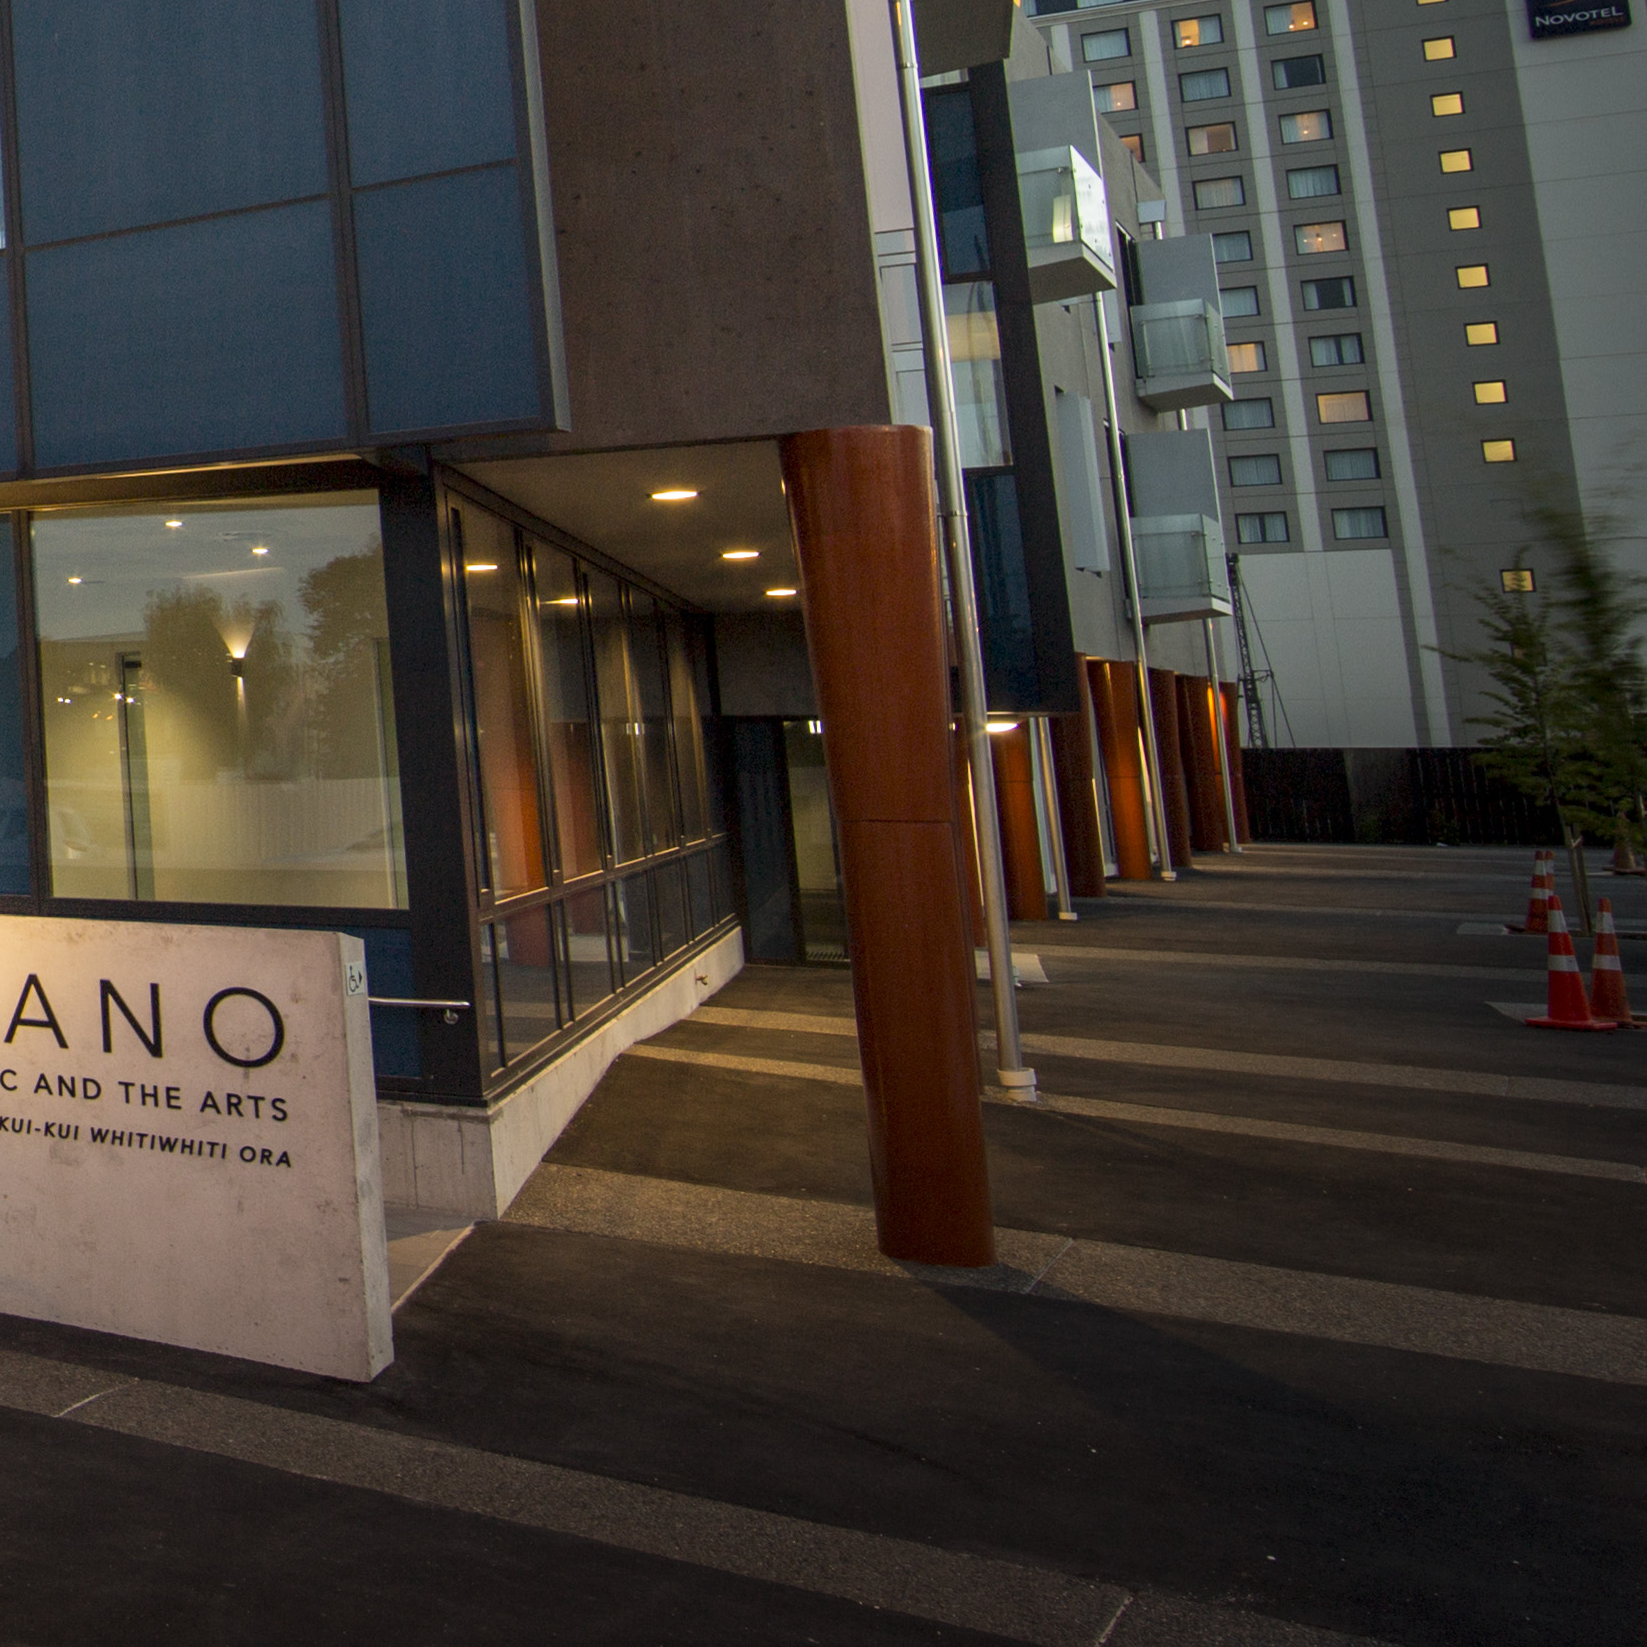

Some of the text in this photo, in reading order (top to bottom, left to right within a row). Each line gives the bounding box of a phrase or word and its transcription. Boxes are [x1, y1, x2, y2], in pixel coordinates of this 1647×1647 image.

[1535, 6, 1623, 27] NOVOTEL
[33, 1073, 102, 1101] AND
[118, 1080, 183, 1110] THE
[200, 1090, 289, 1122] ARTS
[90, 1127, 228, 1160] WHITIWHITI
[239, 1145, 292, 1168] ORA
